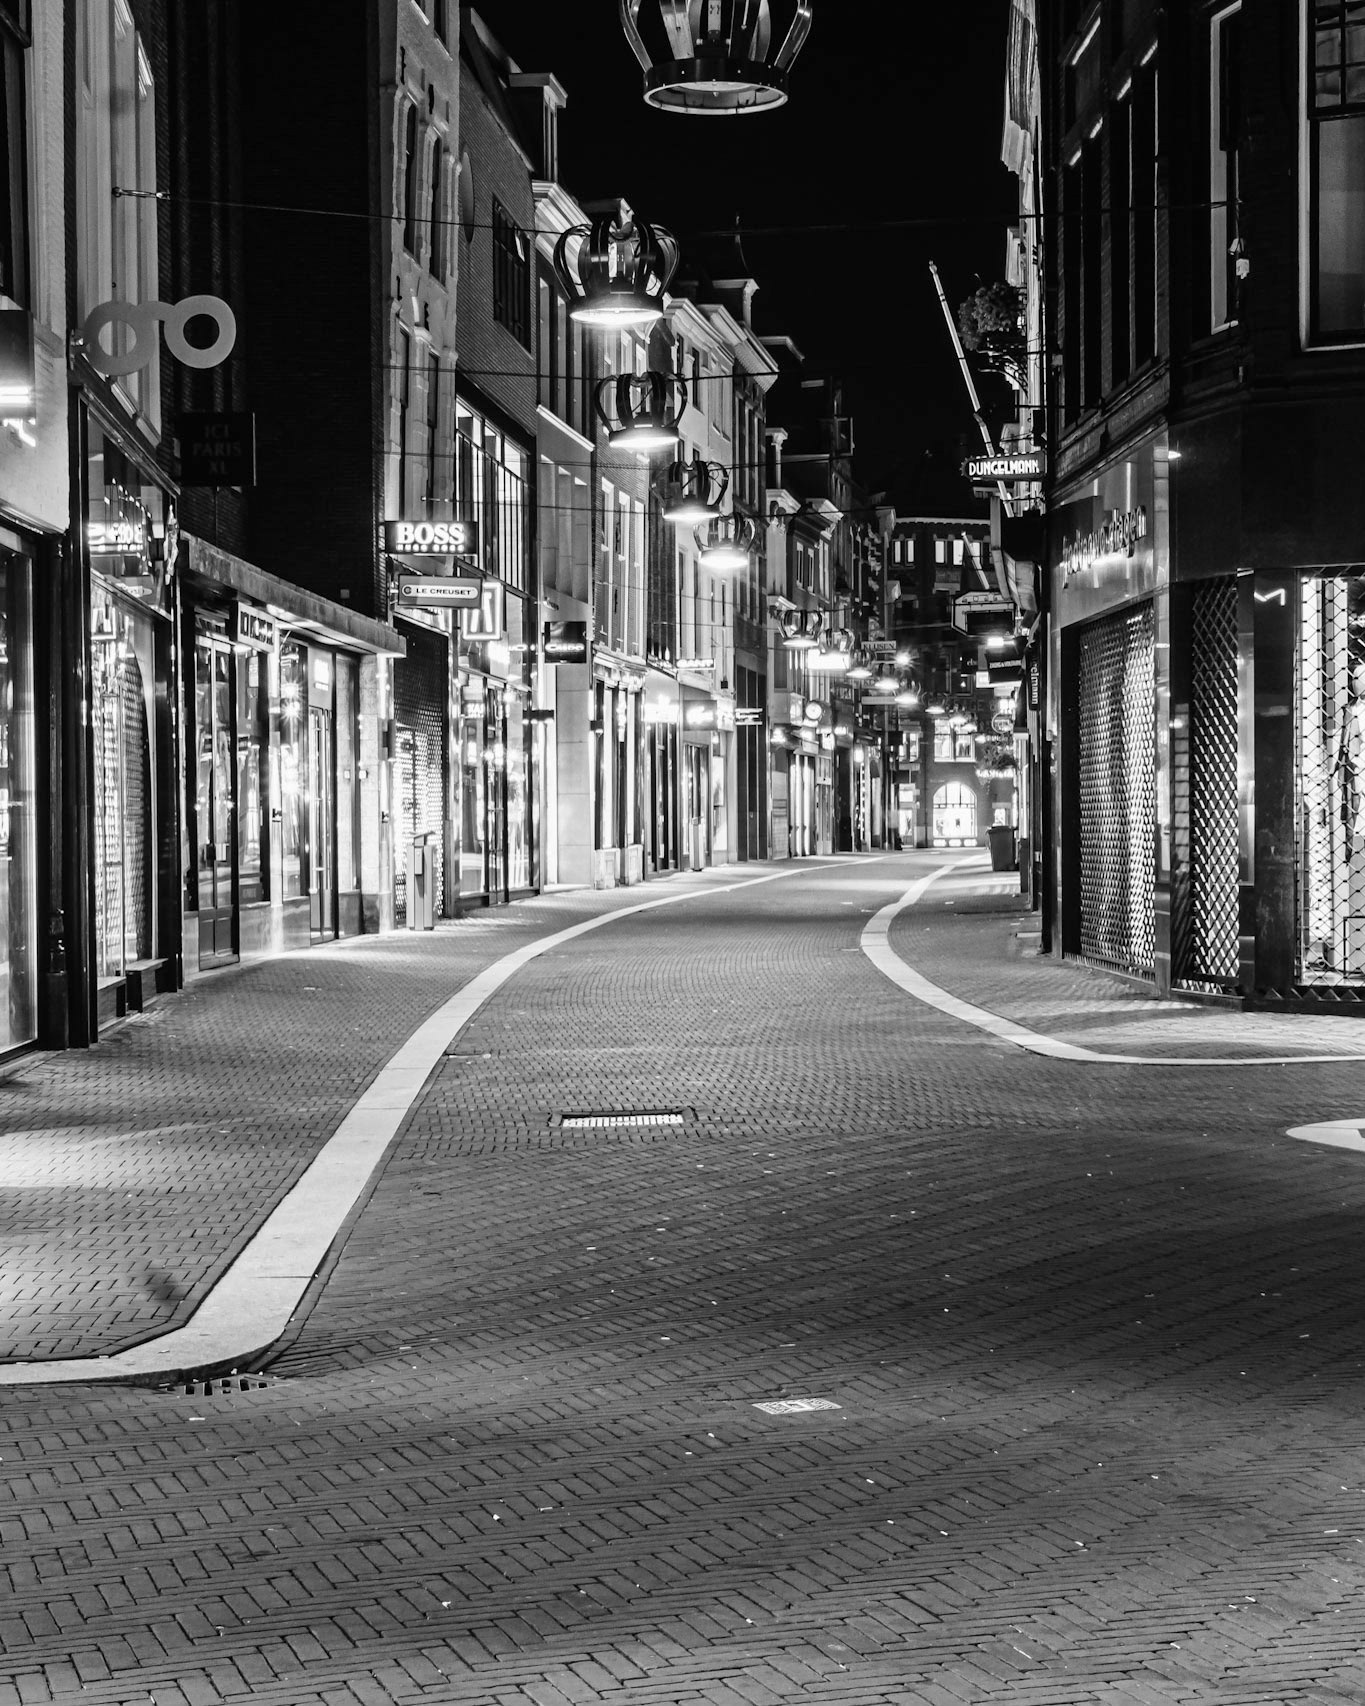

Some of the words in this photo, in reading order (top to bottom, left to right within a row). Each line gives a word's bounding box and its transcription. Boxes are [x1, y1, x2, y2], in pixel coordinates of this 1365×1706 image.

[192, 441, 242, 457] PARIS
[968, 459, 1040, 476] DUNGELMANN
[396, 522, 465, 544] BOSS
[430, 588, 472, 596] CREUSET
